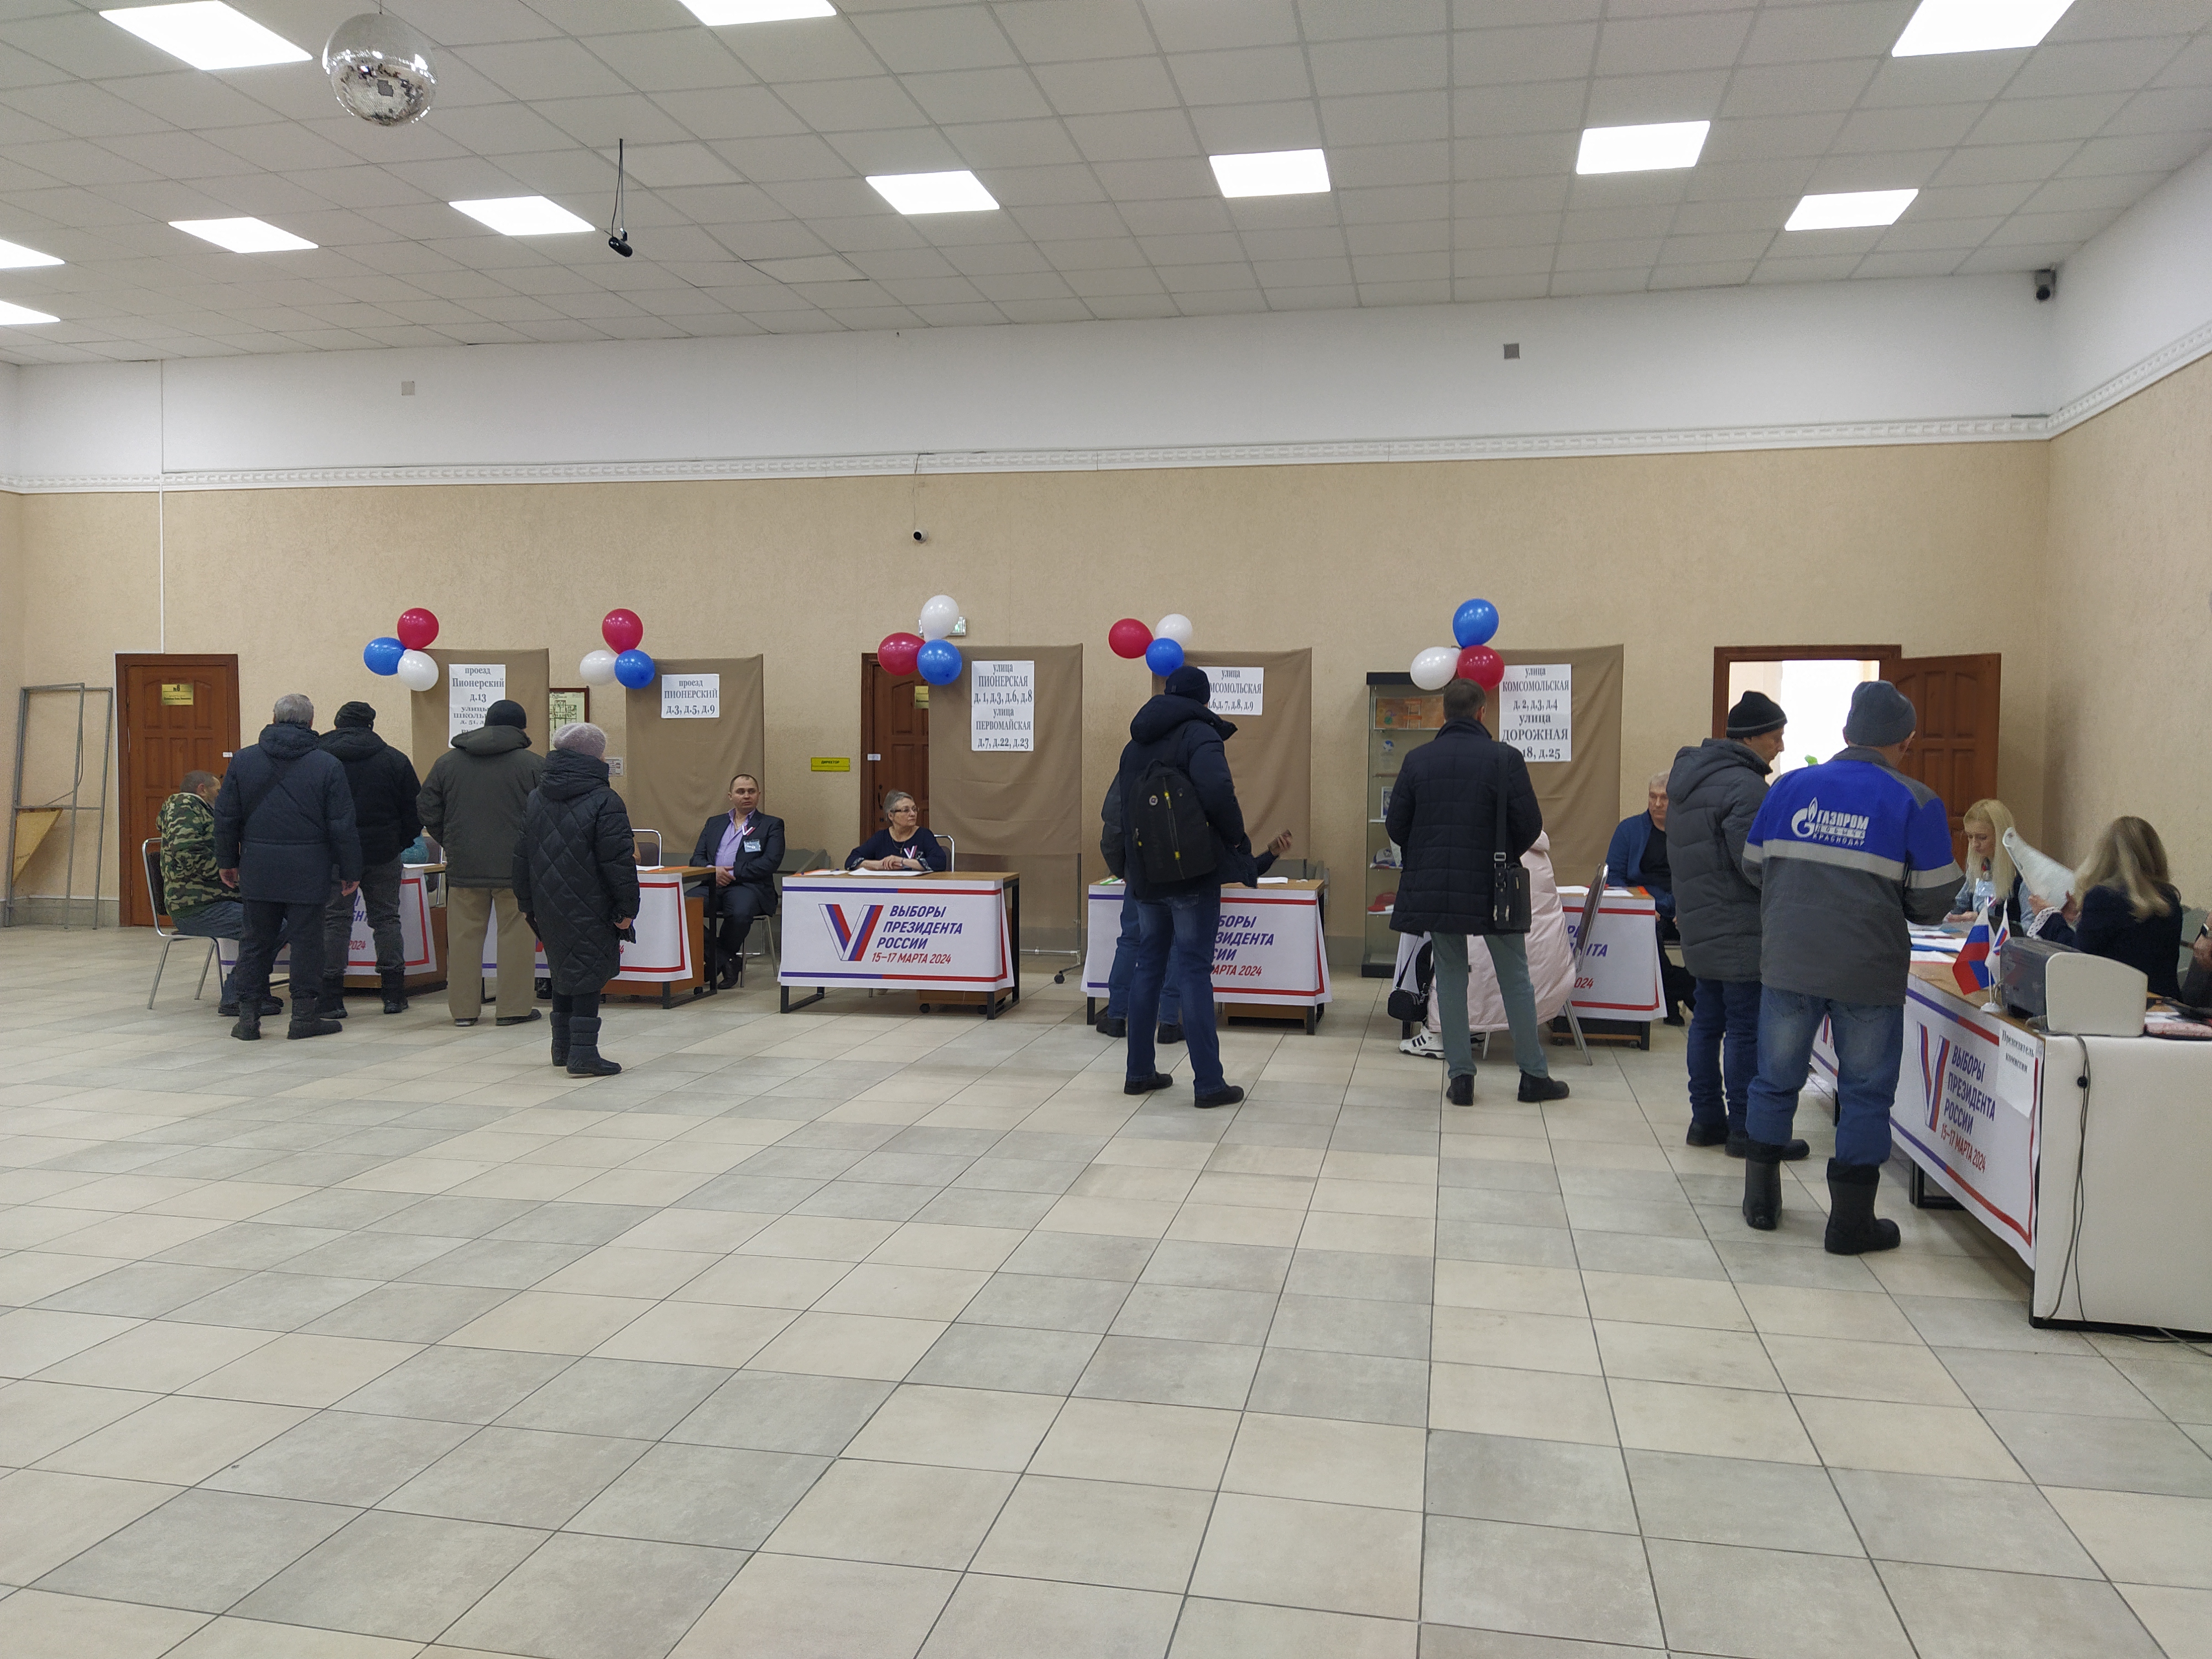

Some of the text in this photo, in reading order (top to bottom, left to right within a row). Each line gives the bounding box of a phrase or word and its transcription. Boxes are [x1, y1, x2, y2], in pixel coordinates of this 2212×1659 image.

[465, 667, 491, 676] проезд
[993, 664, 1013, 675] улица
[1221, 670, 1240, 680] улица
[1525, 667, 1546, 679] улица
[452, 678, 504, 690] Пионерский
[679, 680, 703, 688] проезд
[978, 675, 1029, 687] ПИОНЕРСКАЯ
[1503, 680, 1569, 692] КОМСОМОЛЬСКАЯ
[664, 687, 718, 699] ПИОНЕРСКИЙ
[1209, 682, 1261, 694] МСОМОЛЬСКАЯ
[470, 693, 487, 703] д.13
[990, 692, 1004, 705] д.3,
[1005, 690, 1019, 705] д.6,
[1020, 689, 1032, 705] д.8
[666, 705, 715, 715] д.3, д.5, д.9
[1244, 701, 1254, 711] д.9
[1531, 699, 1545, 711] д.3,
[1546, 698, 1558, 711] д.4
[993, 708, 1014, 718] улица
[976, 719, 1031, 731] ПЕРВОМАЙСКАЯ
[1519, 714, 1551, 726] улица
[1502, 728, 1568, 743] ДОРОЖНАЯ
[978, 738, 1029, 749] д.7, д.22, д.23
[1538, 748, 1561, 760] д.25
[1817, 810, 1870, 830] ГАЗПРОМ
[1814, 824, 1865, 838] ДОБЫЧА
[1813, 833, 1865, 847] КРАСНОДАР
[889, 905, 947, 917] ВЫБОРЫ
[1219, 915, 1258, 928] БОРЫ
[883, 921, 963, 935] ПРЕЗИДЕНТА
[876, 937, 928, 950] РОССИИ
[1215, 932, 1275, 946] ЗИДЕНТА
[897, 953, 928, 964] МАРТА
[929, 953, 952, 964] 2024
[1212, 964, 1262, 977] АРТА 2024
[1574, 977, 1594, 989] 024
[1952, 1045, 1985, 1083] ВЫБОРЫ
[1948, 1072, 1996, 1121] ПРЕЗИДЕНТА
[1944, 1097, 1974, 1135] РОССИИ
[1955, 1135, 1973, 1163] МАРТА
[1973, 1148, 1986, 1173] 2024
